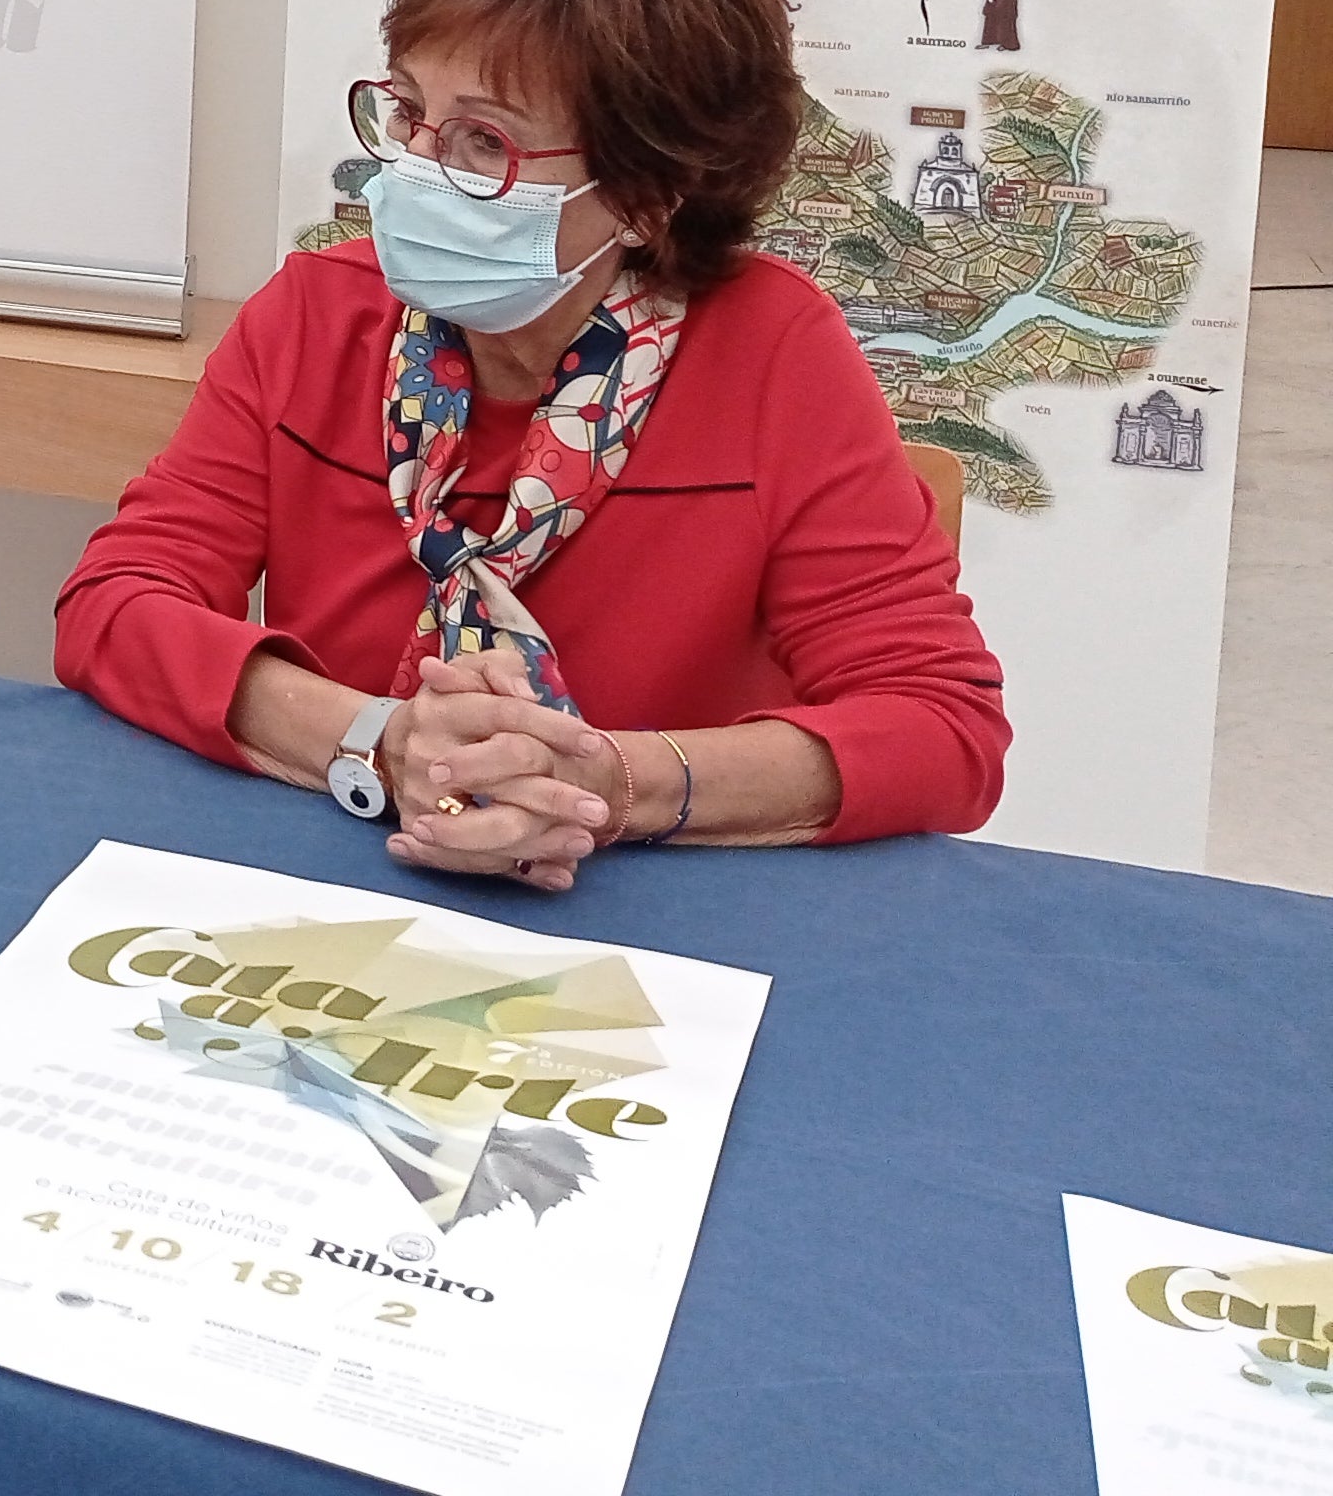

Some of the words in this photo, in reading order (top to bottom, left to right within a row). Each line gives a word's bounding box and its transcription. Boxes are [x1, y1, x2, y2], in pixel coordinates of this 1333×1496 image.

[67, 925, 386, 1022] Cata
[218, 1029, 669, 1142] Arte
[526, 1054, 624, 1083] EDICIÓN
[35, 1176, 51, 1189] e
[56, 1180, 161, 1216] accións
[169, 1206, 283, 1249] culturais
[106, 1179, 175, 1205] Cata
[180, 1197, 211, 1215] de
[220, 1204, 289, 1236] viños
[22, 1210, 61, 1234] 4
[112, 1227, 182, 1262] 10
[232, 1260, 304, 1297] 18
[374, 1300, 419, 1328] 2
[306, 1237, 495, 1303] Ribeiro
